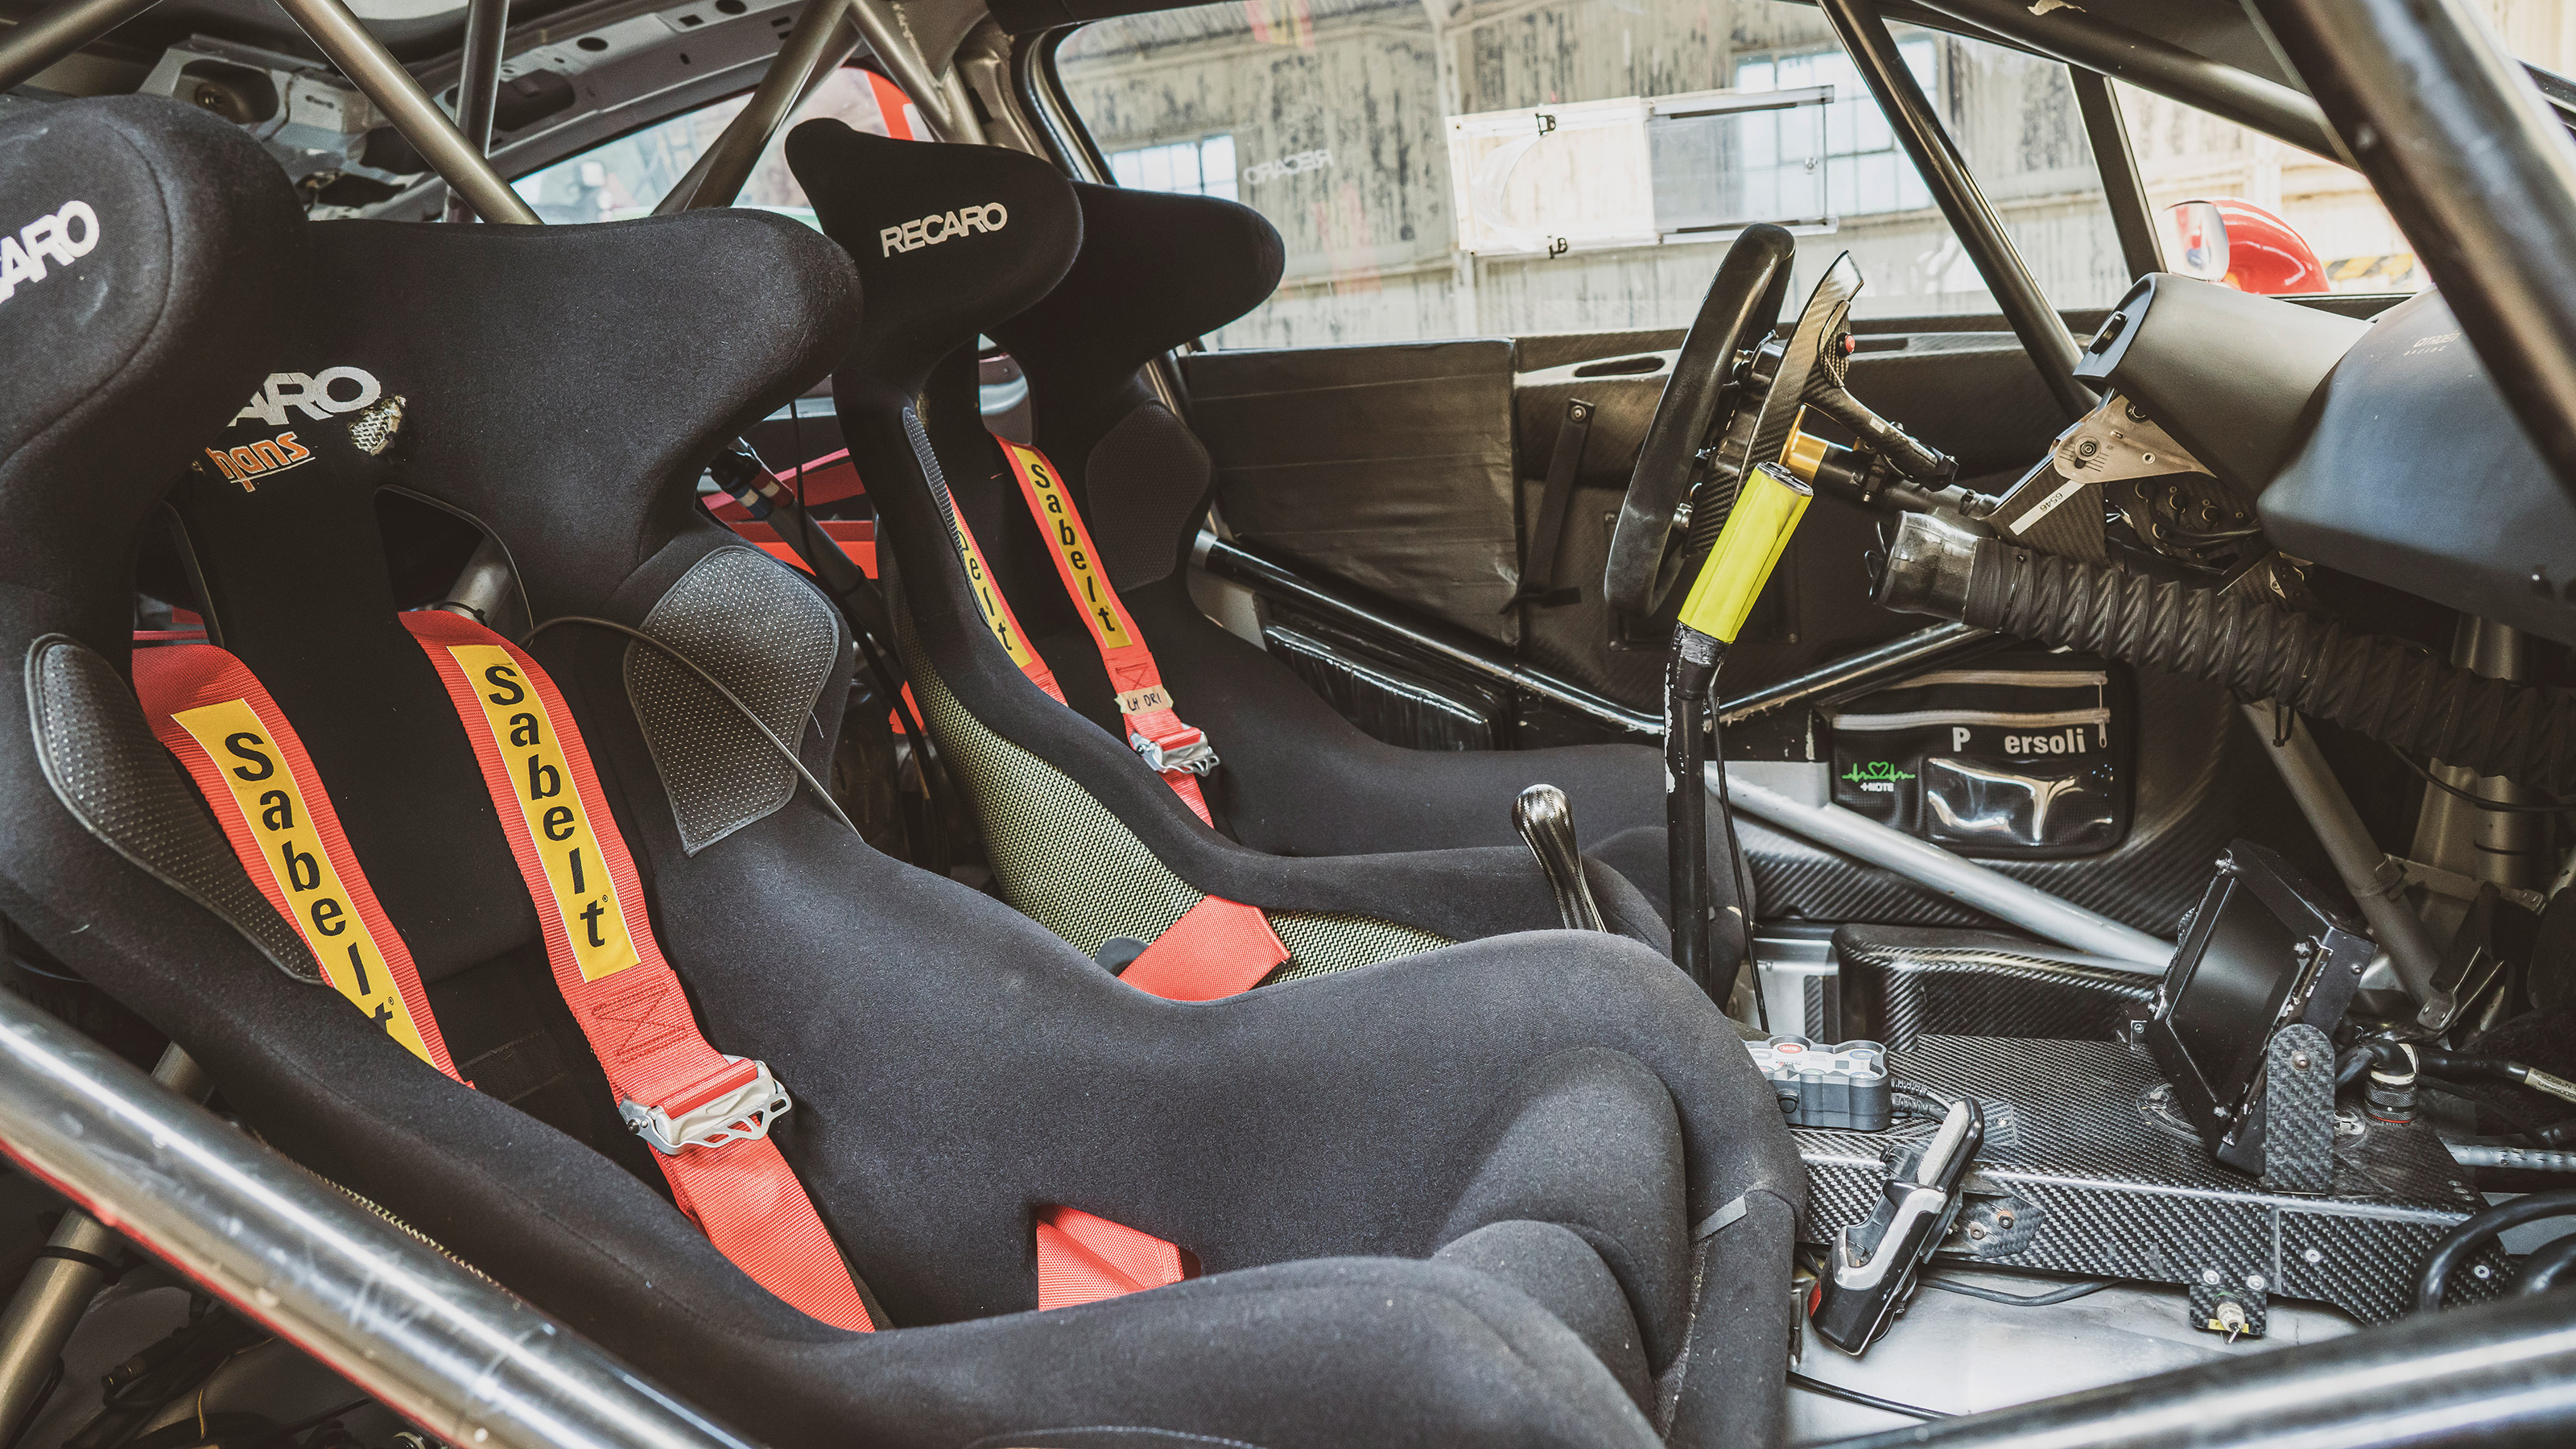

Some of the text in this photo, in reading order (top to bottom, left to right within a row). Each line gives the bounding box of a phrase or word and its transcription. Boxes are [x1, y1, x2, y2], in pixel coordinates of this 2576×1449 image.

[0, 200, 100, 304] ARO
[880, 202, 1008, 258] RECARO
[1030, 464, 1116, 632] Sabelt
[2039, 492, 2063, 512] 6546
[957, 530, 1013, 651] elt
[1952, 727, 2087, 754] P ersoli
[485, 665, 605, 947] Sabelt
